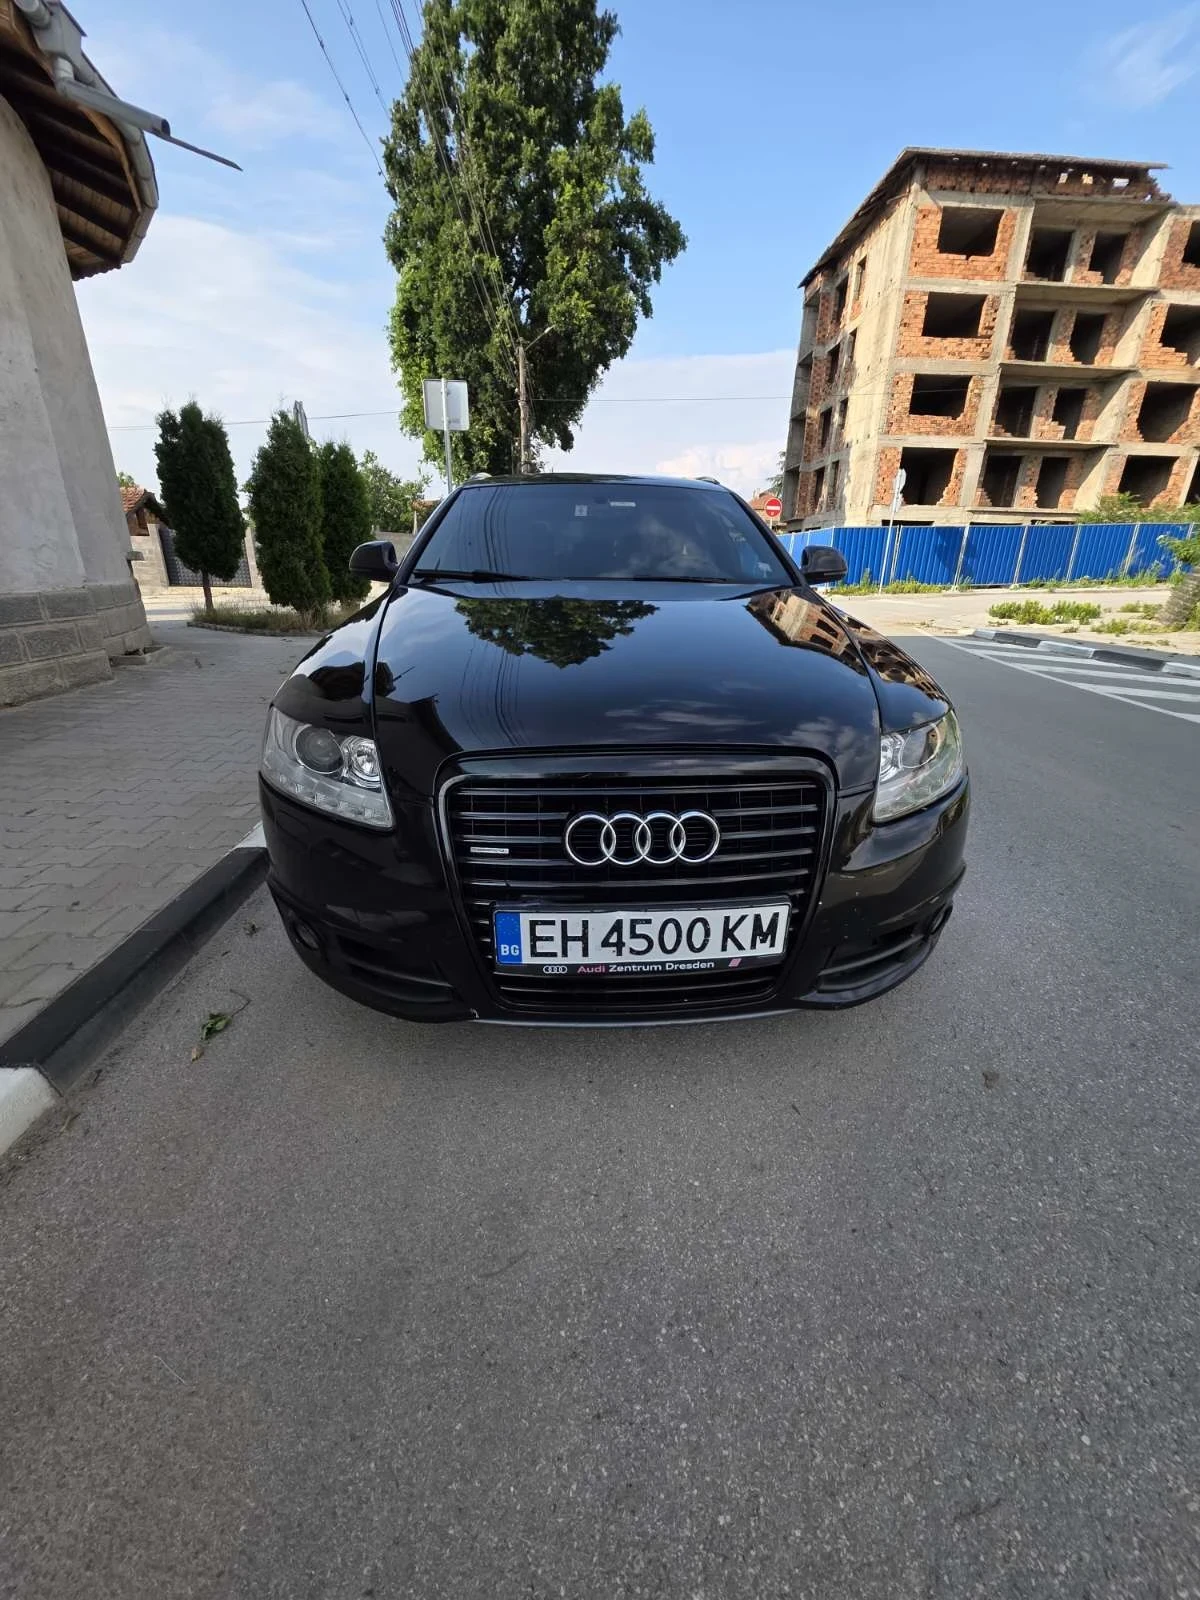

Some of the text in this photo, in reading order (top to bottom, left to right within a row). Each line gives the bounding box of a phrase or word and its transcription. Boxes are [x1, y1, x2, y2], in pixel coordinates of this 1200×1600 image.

[529, 912, 780, 958] EH 4500 KM
[501, 944, 519, 956] BG
[609, 963, 662, 972] Zentrum
[665, 961, 715, 970] Dresden
